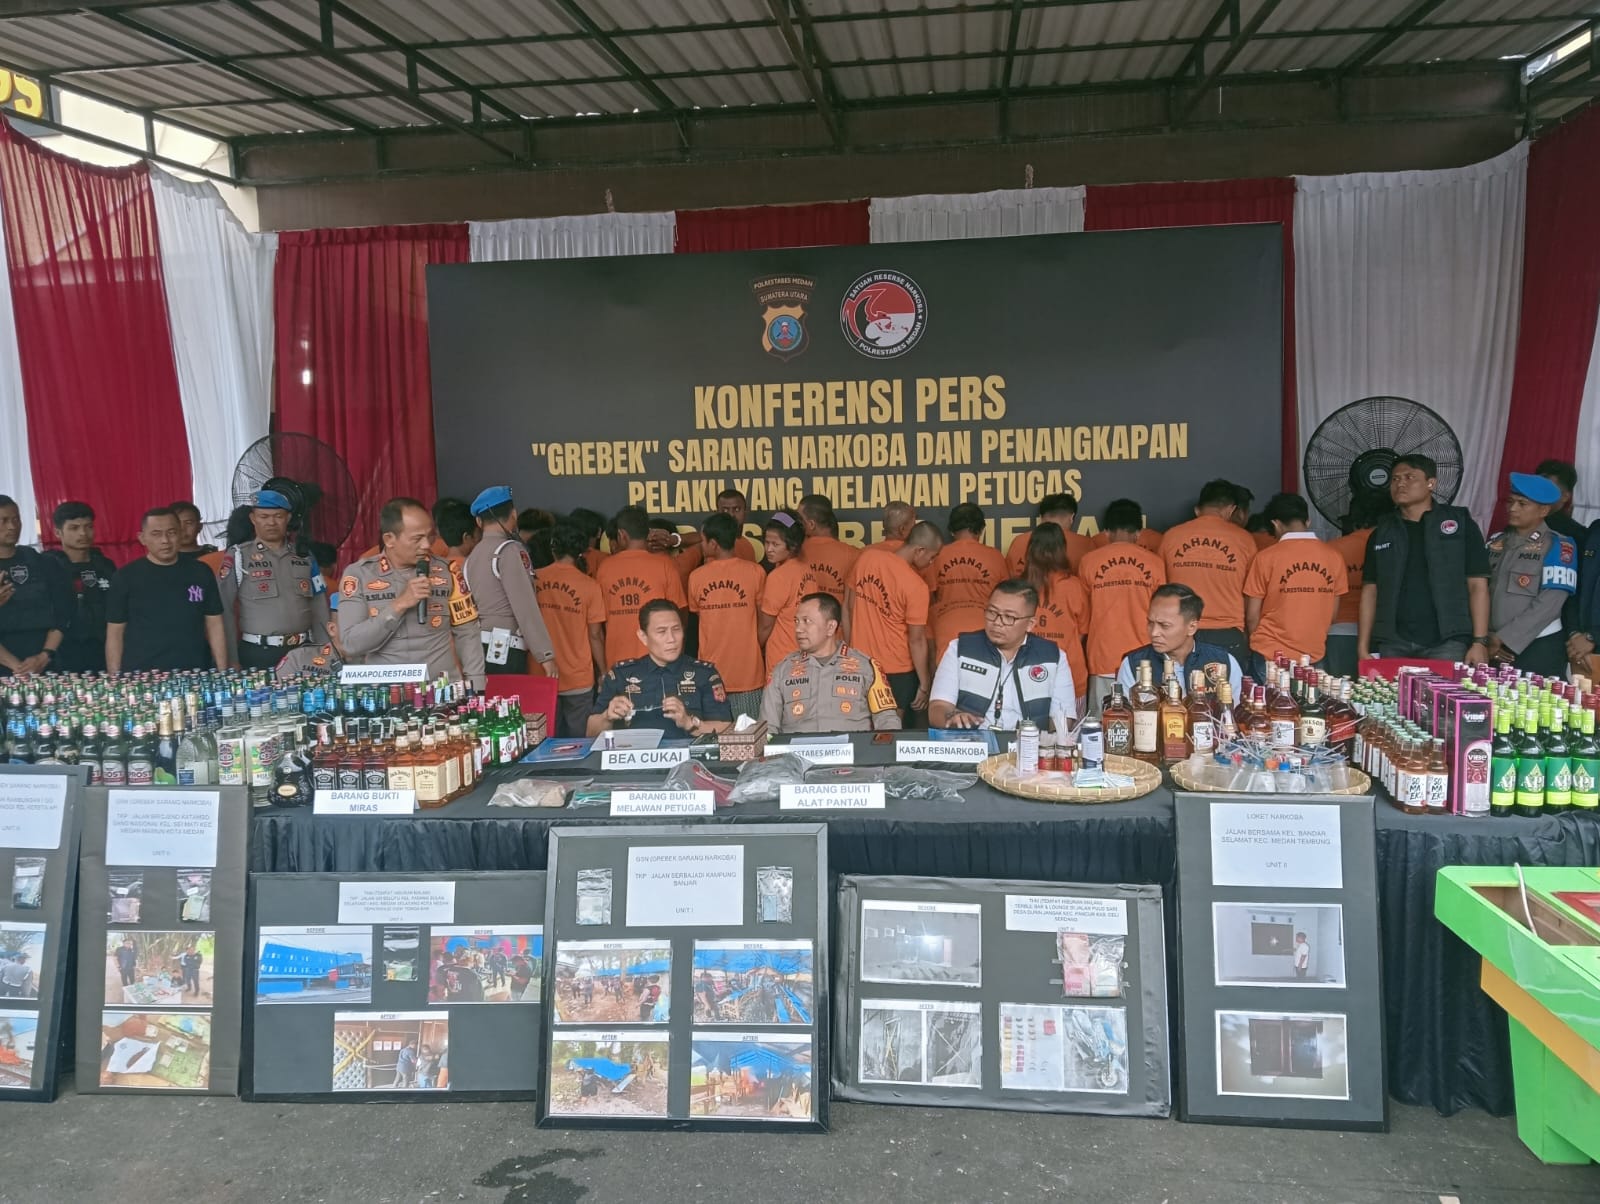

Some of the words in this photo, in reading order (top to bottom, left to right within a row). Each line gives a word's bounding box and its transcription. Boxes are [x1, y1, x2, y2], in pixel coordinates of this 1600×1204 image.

[753, 277, 791, 290] POLRESTABES
[792, 278, 814, 288] MEDAN
[760, 290, 788, 303] SUMATERA
[789, 291, 809, 302] UTARA
[849, 277, 873, 299] SATUAN
[874, 273, 906, 284] RESERSE
[904, 279, 923, 315] NARKOBA
[859, 342, 907, 357] POLRESTABES
[905, 321, 923, 346] MEDAN
[694, 379, 903, 430] KONFERENSI
[916, 374, 1007, 423] PERS
[532, 439, 659, 476] "GREBEK"
[668, 436, 773, 473] SARANG
[781, 432, 907, 470] NARKOBA
[916, 429, 972, 466] DAN
[981, 423, 1189, 464] PENANGKAPAN
[628, 480, 726, 514] PELAKU
[733, 477, 804, 512] YANG
[812, 474, 950, 510] MELAWAN
[959, 468, 1082, 506] PETUGAS
[1174, 537, 1237, 564] TAHANAN
[1518, 552, 1540, 561] POLRI
[810, 561, 845, 587] HANAN
[938, 556, 991, 579] TAHANAN
[1095, 557, 1152, 581] TAHANAN
[1279, 561, 1334, 586] TAHANAN
[609, 577, 652, 596] TAHANAN
[699, 580, 747, 602] TAHANAN
[536, 581, 581, 606] AHANAN
[620, 593, 641, 607] 198
[344, 668, 423, 679] WAKAPOLRESTABES
[962, 663, 987, 674] KASAT
[835, 675, 861, 683] POLRI
[608, 752, 638, 765] BEA
[641, 751, 683, 764] CUKAI
[825, 749, 852, 757] MEDAN
[899, 746, 927, 756] KASAT
[928, 746, 986, 757] RESNARKOBA
[331, 791, 369, 800] BARANG
[371, 791, 400, 800] BUKTI
[794, 785, 838, 795] BARANG
[839, 784, 871, 794] BUKTI
[629, 793, 667, 801] BARANG
[668, 792, 696, 801] BUKTI
[797, 798, 821, 808] ALAT
[822, 798, 868, 808] PANTAU
[350, 804, 378, 812] MIRAS
[616, 803, 662, 813] MELAWAN
[664, 802, 707, 812] PETUGAS
[1270, 813, 1304, 821] NARKOBA
[678, 854, 704, 862] SARANG
[675, 906, 690, 914] UNIT
